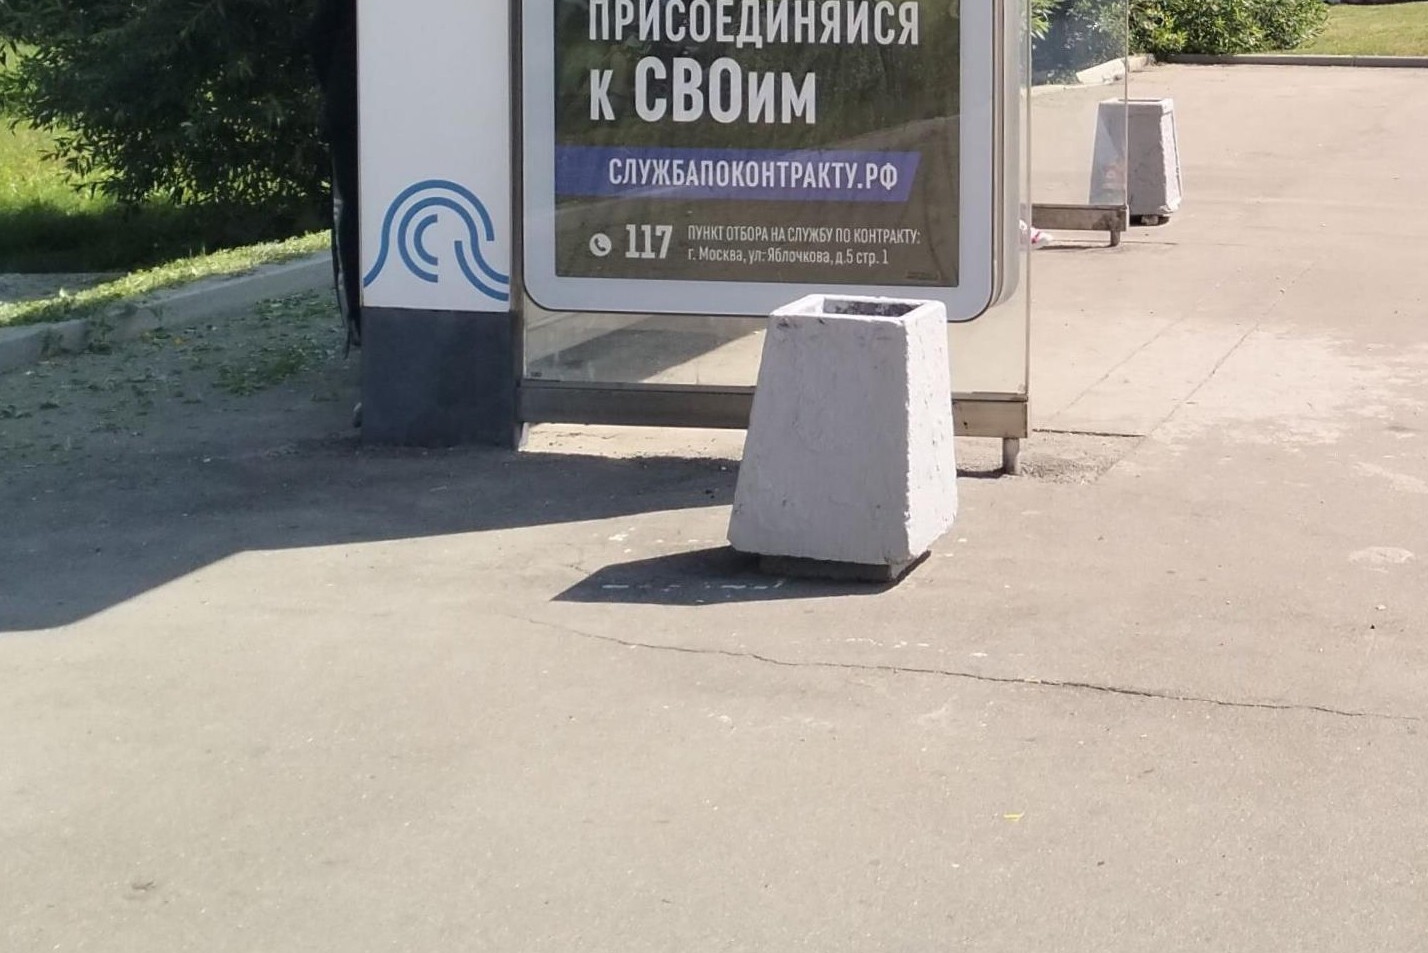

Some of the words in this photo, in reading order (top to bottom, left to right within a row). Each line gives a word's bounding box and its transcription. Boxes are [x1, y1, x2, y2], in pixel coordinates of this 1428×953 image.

[609, 158, 898, 191] СЛУЖБАПОКОНТРАКТУ.РФ
[625, 224, 673, 259] 117
[688, 225, 724, 241] ПУНКТ
[726, 225, 769, 242] ОТБОРА
[771, 227, 786, 242] НА
[788, 227, 834, 243] СЛУЖБУ
[836, 228, 851, 244] ПО
[853, 229, 921, 245] КОНТРАКТУ:
[688, 249, 697, 261] г.
[699, 246, 747, 264] Москва,
[768, 247, 834, 265] Яблочкова,
[856, 252, 880, 267] стр.
[883, 249, 889, 265] 1
